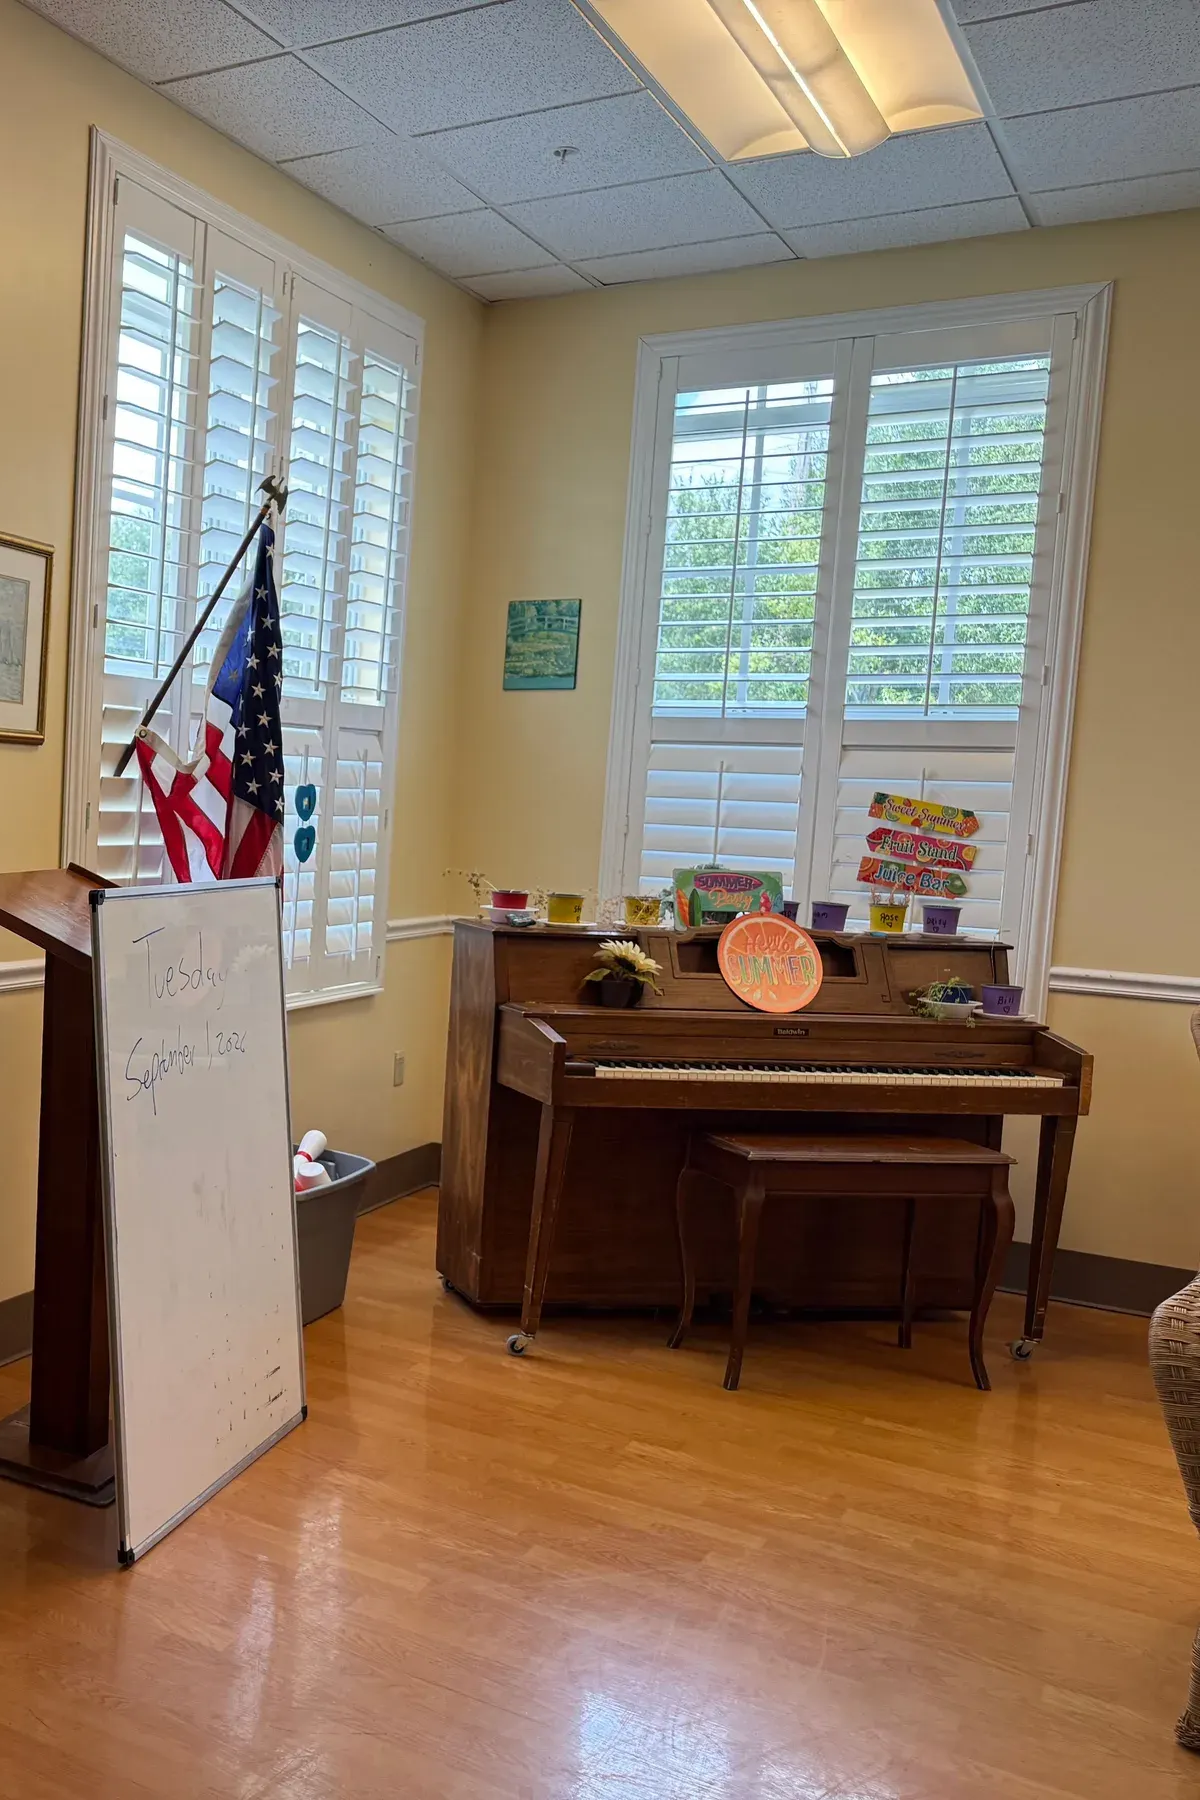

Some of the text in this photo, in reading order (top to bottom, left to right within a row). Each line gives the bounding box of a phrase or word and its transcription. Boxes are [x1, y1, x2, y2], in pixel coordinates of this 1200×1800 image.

[884, 799, 965, 831] Sweet Summer
[880, 836, 958, 861] Fruit Stand
[700, 876, 754, 890] SUMMER
[875, 864, 950, 891] Juice Bar
[708, 888, 754, 909] Party
[745, 933, 791, 953] Hello
[132, 926, 228, 1011] Tuesday
[726, 954, 818, 986] SUMMER
[997, 996, 1014, 1005] Bill
[126, 1025, 195, 1116] September
